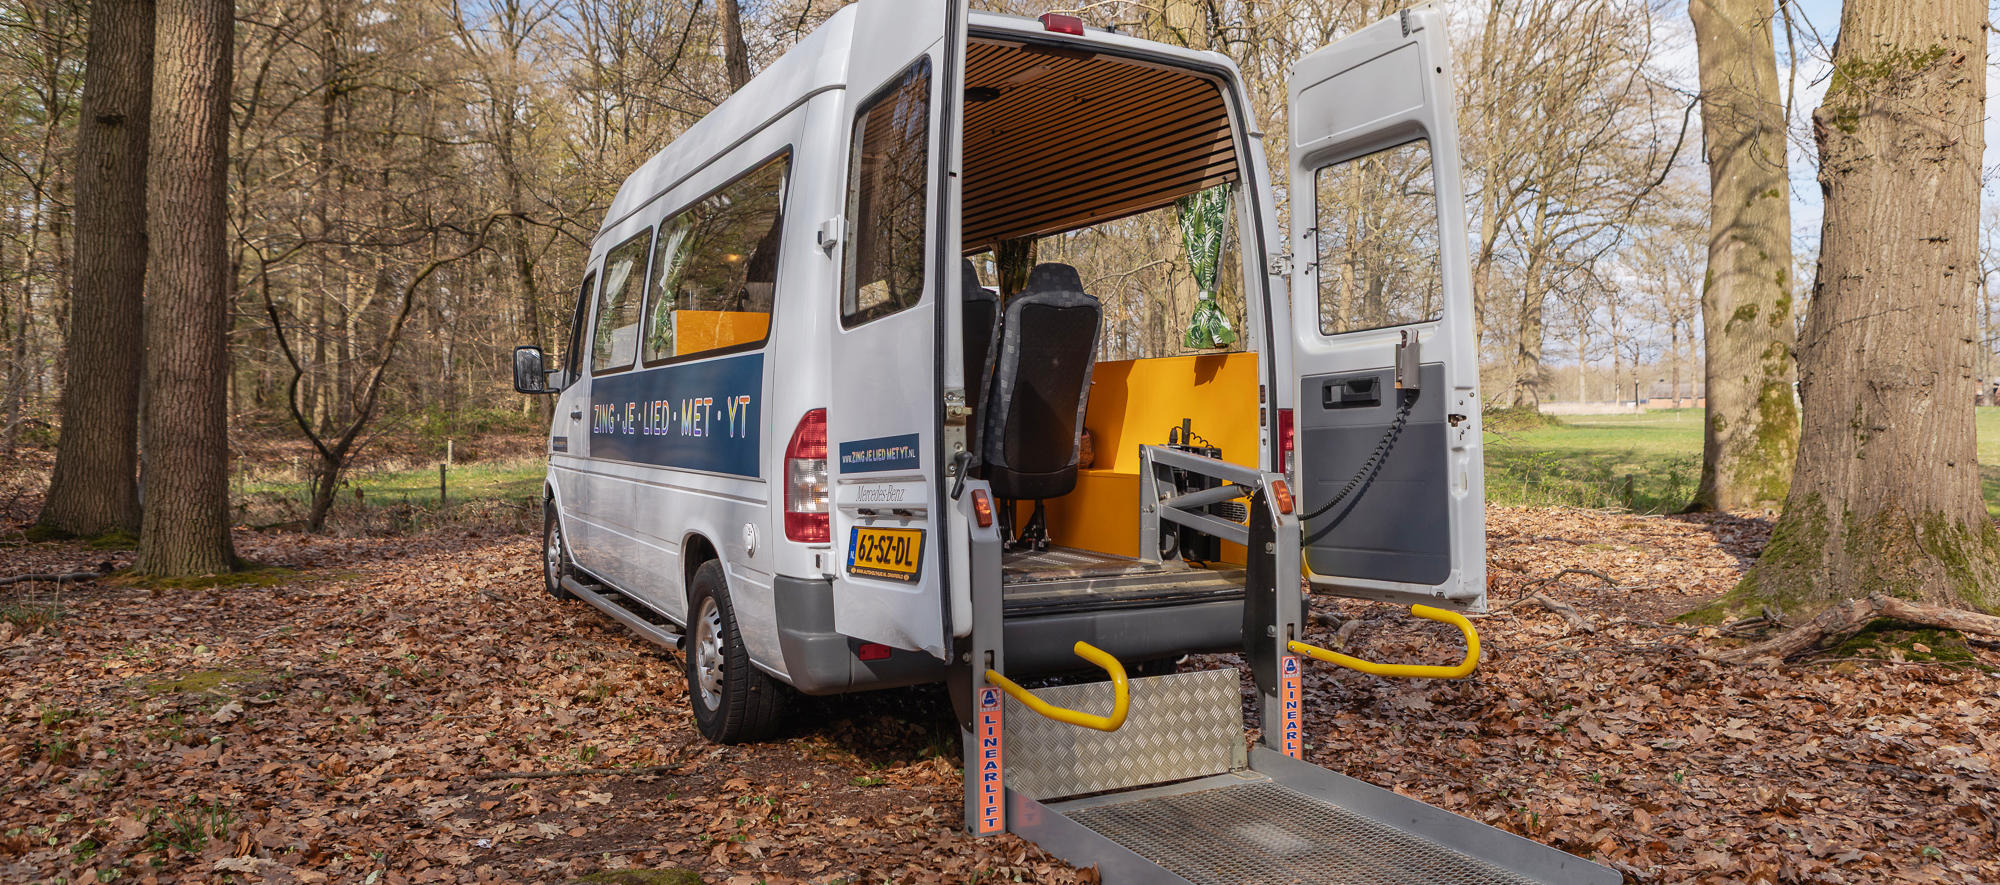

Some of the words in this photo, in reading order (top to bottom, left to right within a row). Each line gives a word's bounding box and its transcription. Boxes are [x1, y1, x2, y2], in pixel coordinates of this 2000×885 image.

[593, 403, 615, 435] ZING
[622, 401, 636, 435] JE
[643, 399, 670, 436] LIED
[681, 397, 713, 437] MET
[727, 395, 751, 439] YT
[855, 484, 905, 502] Mercedes-Benz
[858, 534, 913, 567] 62-SZ-DL
[1286, 681, 1298, 758] LINEARLI
[983, 715, 999, 828] LINEARLIFT
